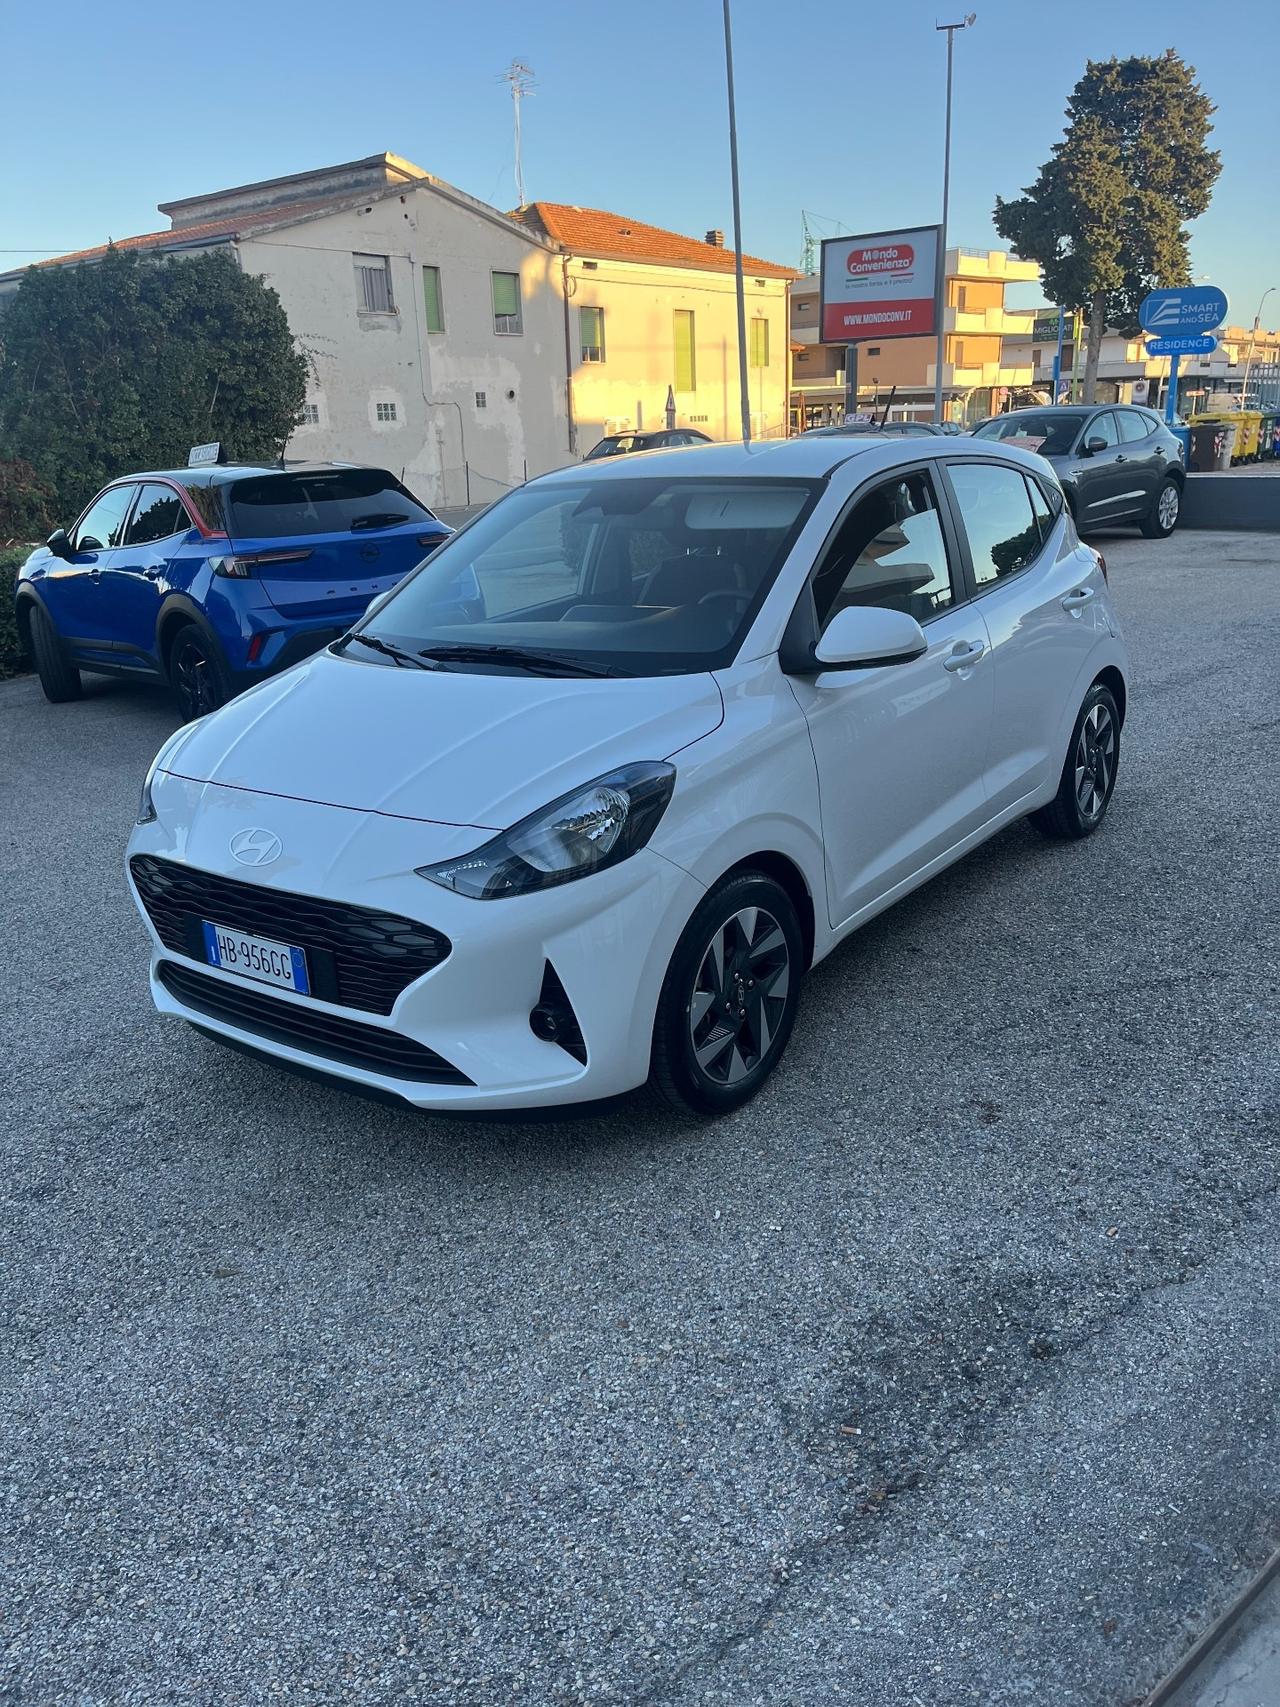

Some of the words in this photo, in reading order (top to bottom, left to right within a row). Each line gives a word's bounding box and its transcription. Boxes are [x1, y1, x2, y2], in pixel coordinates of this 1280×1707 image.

[862, 248, 898, 261] Mondo
[1181, 302, 1220, 314] SMART
[843, 310, 912, 326] WWW.MONDOCONV.IT
[1198, 313, 1219, 323] SEA
[1034, 324, 1073, 334] MIGLIOATI
[1150, 338, 1210, 350] RESIDENCE
